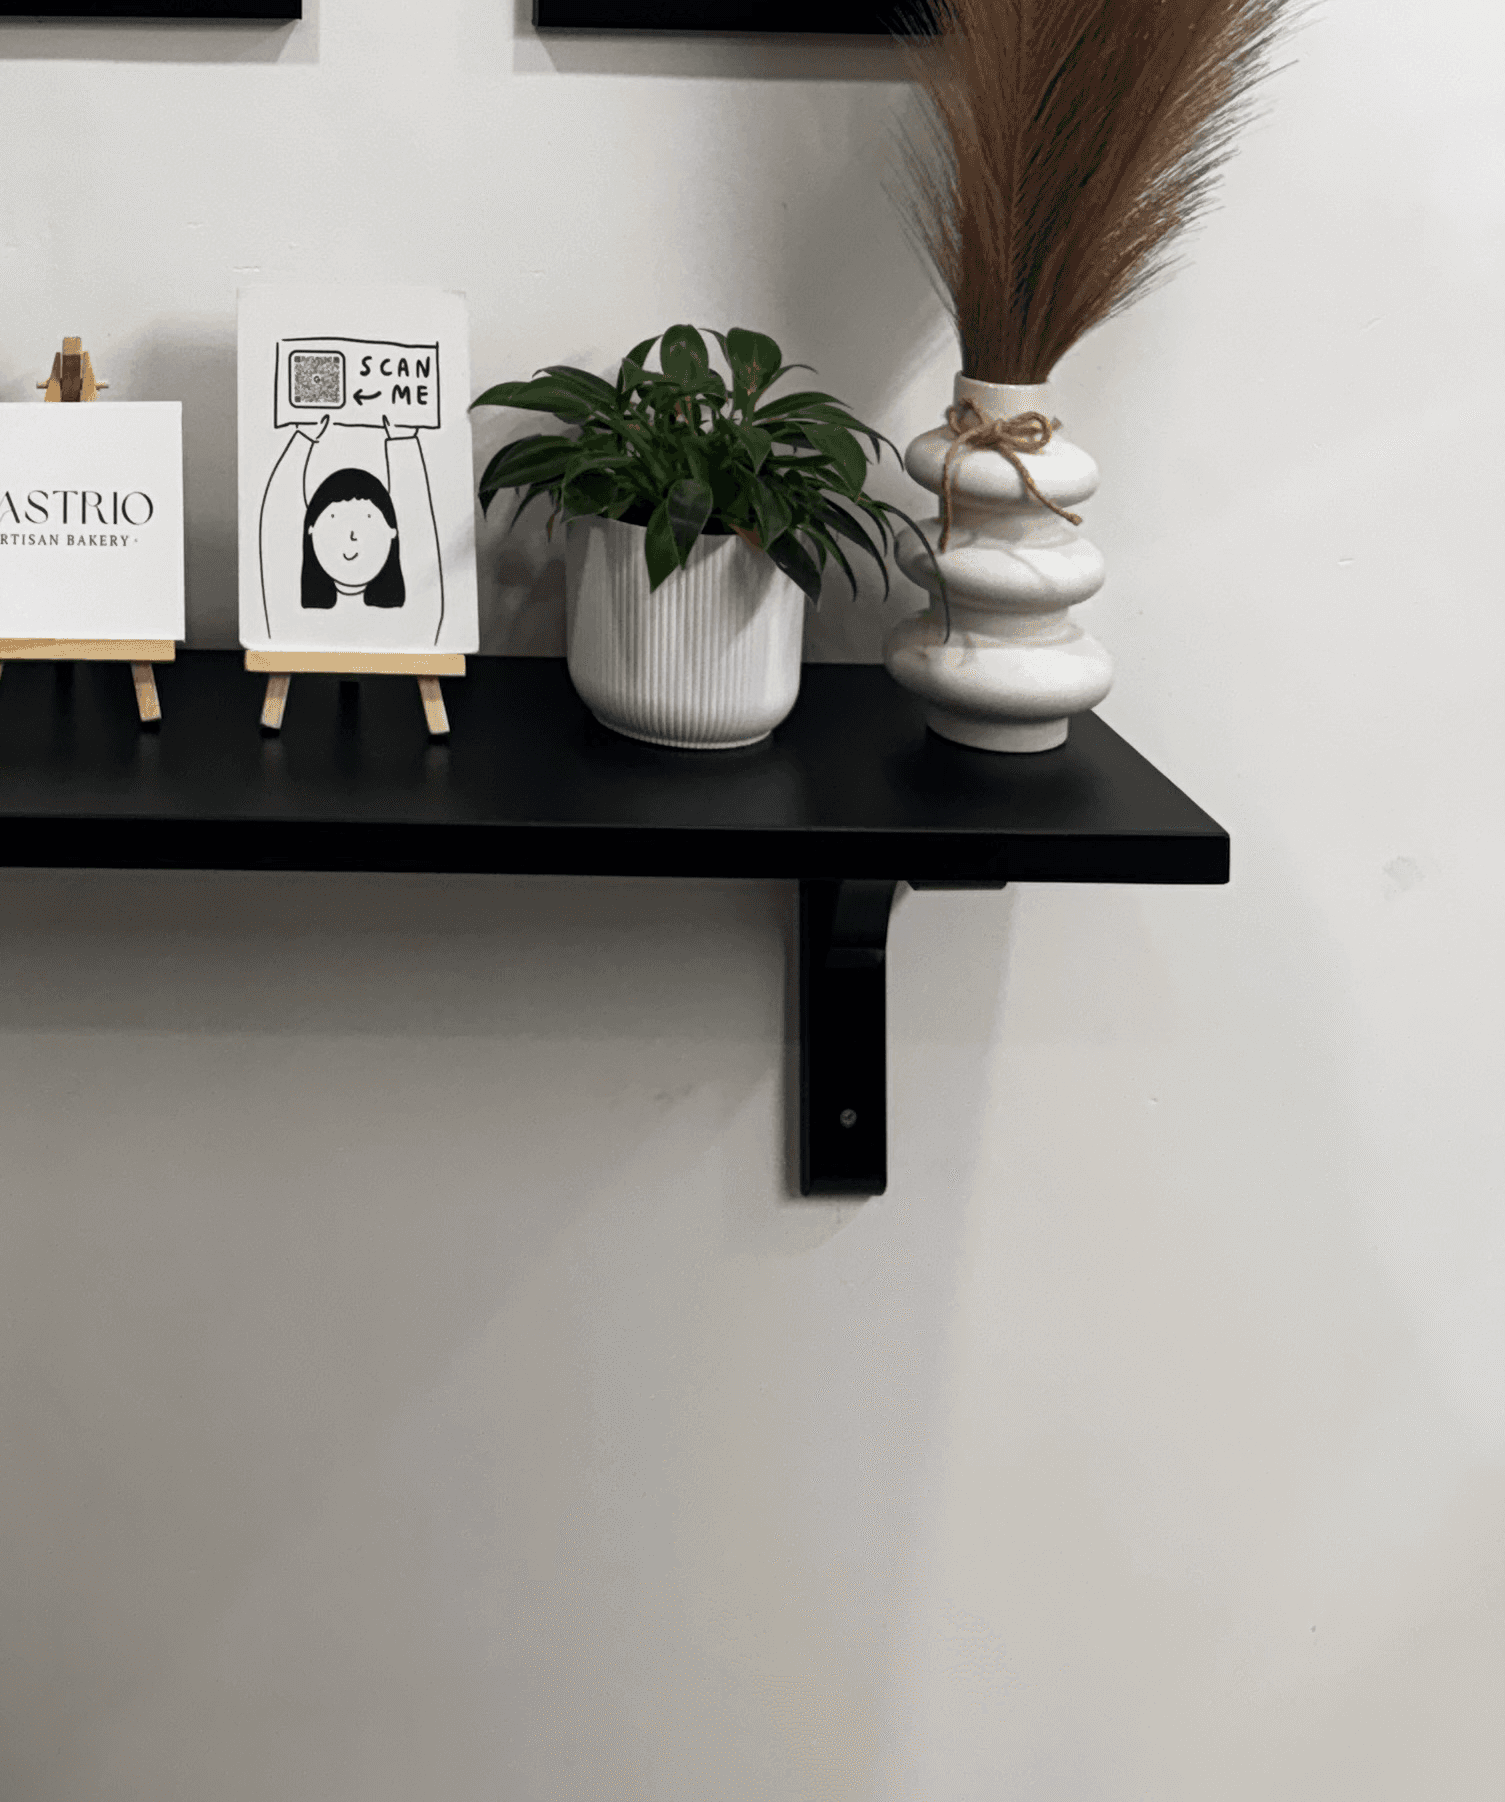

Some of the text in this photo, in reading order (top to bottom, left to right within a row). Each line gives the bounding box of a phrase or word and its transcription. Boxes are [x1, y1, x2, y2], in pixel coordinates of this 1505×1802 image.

[359, 355, 430, 378] SCAN
[391, 384, 429, 405] ME
[66, 534, 129, 547] BAKERY
